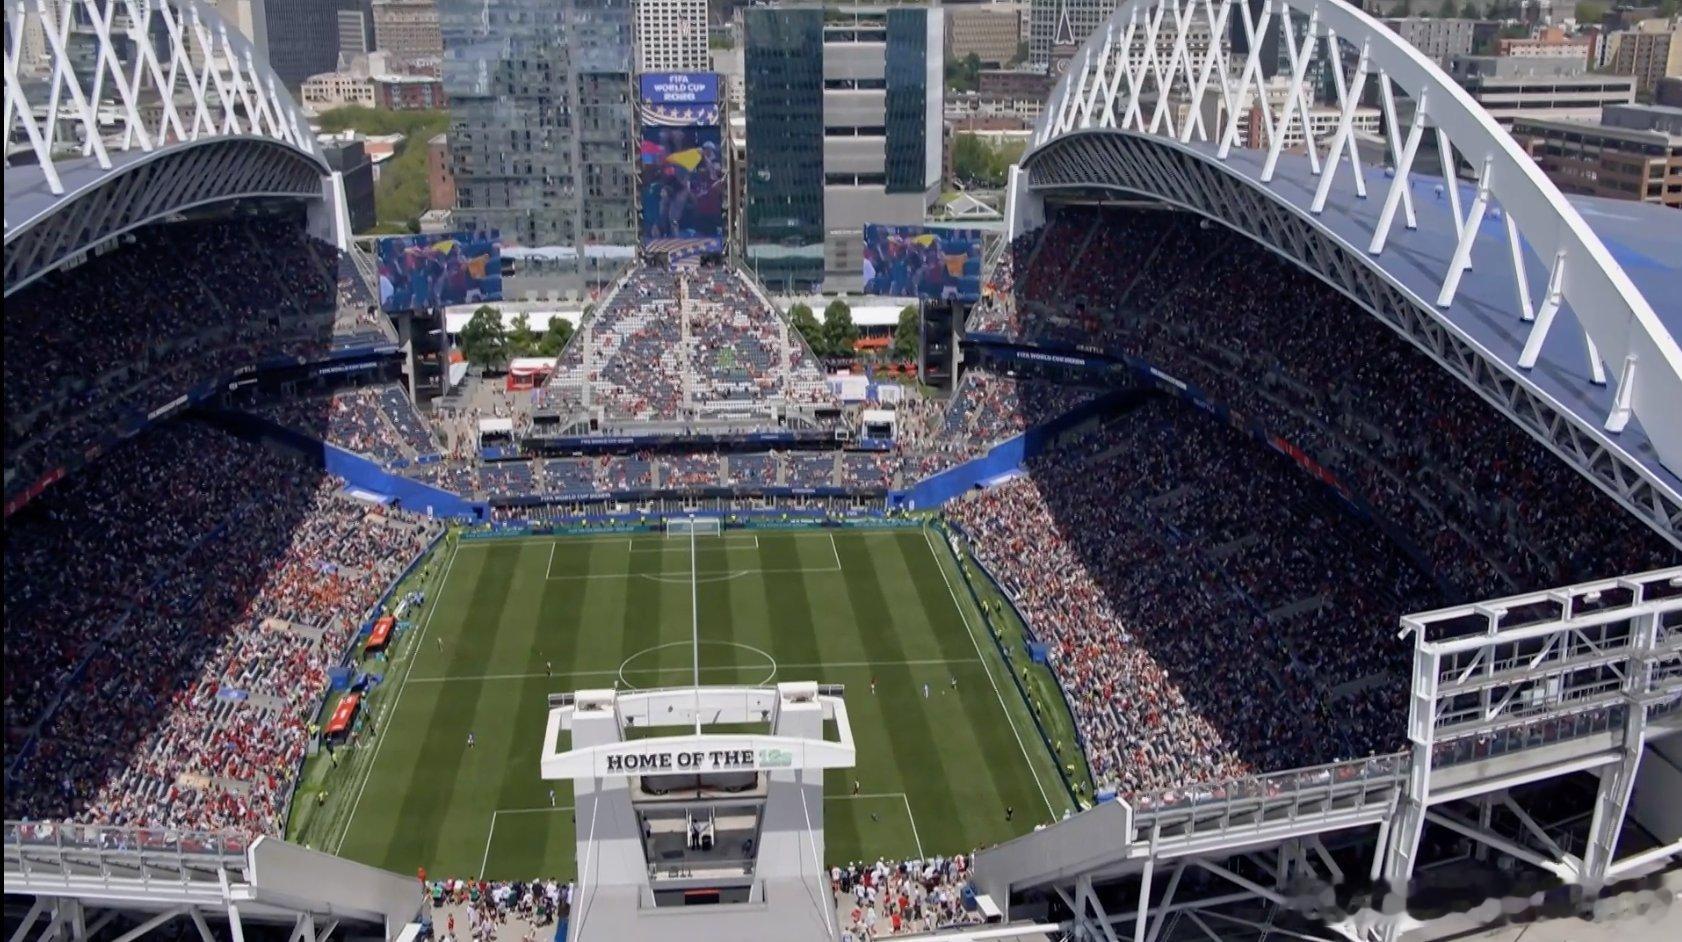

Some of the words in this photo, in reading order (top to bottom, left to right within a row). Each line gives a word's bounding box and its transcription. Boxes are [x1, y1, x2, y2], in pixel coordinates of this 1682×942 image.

[669, 75, 689, 83] FIFA
[653, 84, 687, 92] WORLD
[687, 84, 706, 92] CUP
[606, 752, 673, 771] HOME
[677, 751, 705, 769] OF
[709, 749, 755, 767] THE
